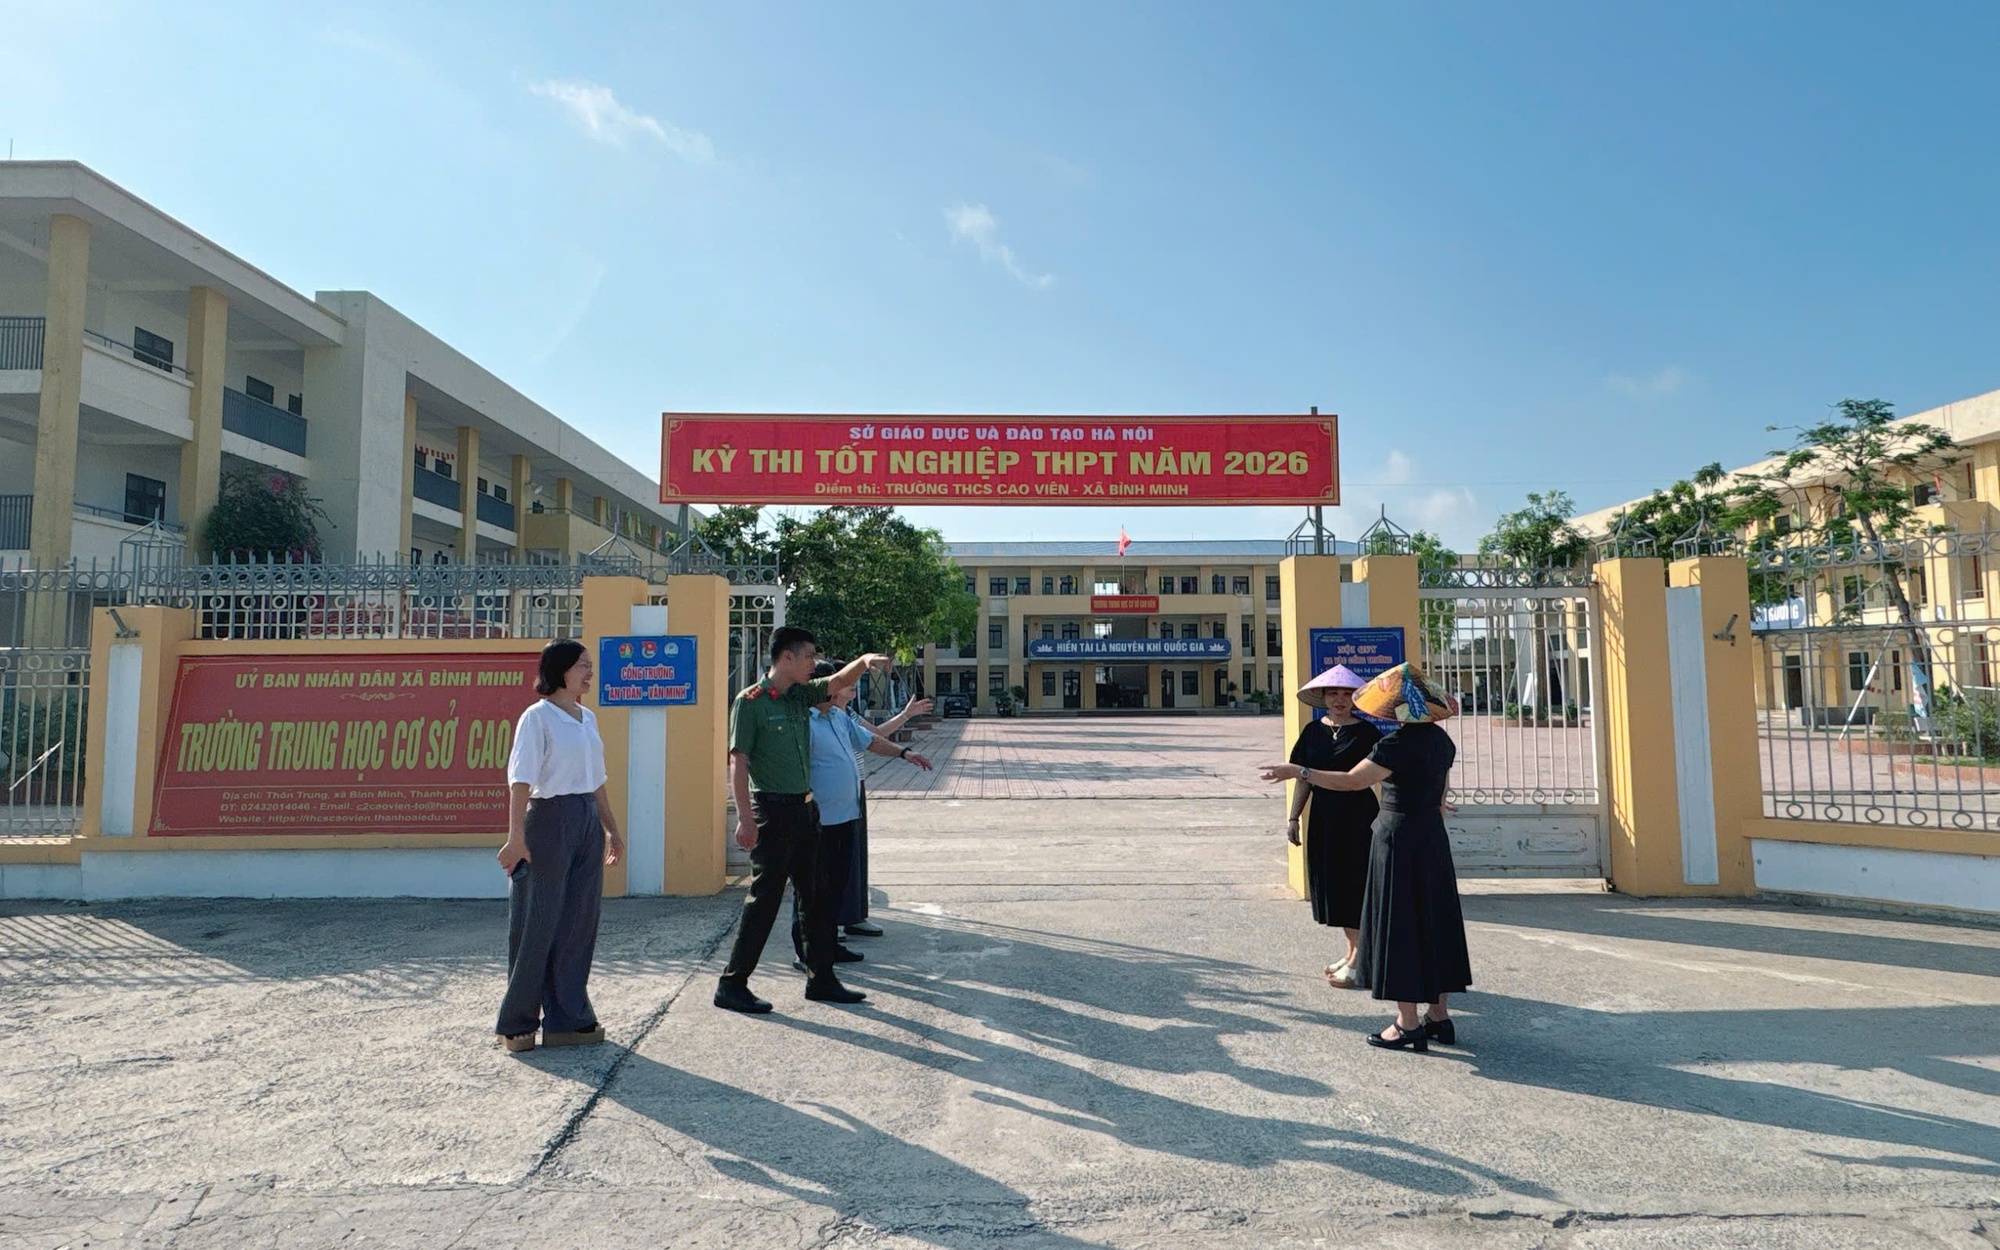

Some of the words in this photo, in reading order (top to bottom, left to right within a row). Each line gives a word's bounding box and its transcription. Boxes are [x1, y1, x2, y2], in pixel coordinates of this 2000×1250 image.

[850, 424, 876, 440] SỞ
[881, 425, 925, 440] GIÁO
[932, 427, 969, 443] DỤC
[976, 426, 1000, 440] VÀ
[1006, 427, 1044, 441] ĐÀO
[1050, 428, 1084, 443] TẠO
[1091, 427, 1115, 441] HÀ
[1122, 427, 1154, 443] NỘI
[692, 444, 738, 474] KỲ
[749, 449, 804, 474] THI
[815, 442, 878, 475] TỐT
[889, 446, 1020, 480] NGHIỆP
[1031, 450, 1118, 476] THPT
[1129, 446, 1212, 476] NĂM
[1223, 451, 1309, 476] 2026
[814, 479, 852, 495] Điểm
[857, 483, 881, 495] thi:
[885, 480, 949, 495] TRƯỜNG
[953, 483, 993, 495] THCS
[997, 483, 1030, 496] CAO
[1034, 482, 1069, 496] VIÊN
[1083, 481, 1105, 496] XÃ
[1109, 481, 1145, 496] BÌNH
[1149, 483, 1189, 496] MINH
[1080, 641, 1094, 653] TÀI
[1095, 641, 1107, 653] LÀ
[1109, 641, 1145, 653] NGUYÊN
[1146, 640, 1162, 653] KHÍ
[1163, 639, 1187, 654] QUỐC
[1189, 642, 1205, 652] GIA
[235, 667, 259, 688] UỶ
[263, 673, 300, 688] BAN
[304, 670, 355, 688] NHÂN
[359, 669, 396, 687] DÂN
[401, 669, 424, 687] XÃ
[429, 668, 472, 687] BÌNH
[477, 671, 524, 686] MINH
[643, 663, 675, 680] TRƯỜNG
[621, 683, 642, 700] TOÀN
[648, 683, 664, 700] VĂN
[664, 682, 691, 700] MINH"
[177, 709, 264, 772] TRƯỜNG
[267, 720, 340, 771] TRUNG
[341, 719, 388, 781] HỌC
[391, 716, 425, 770] CƠ
[425, 699, 460, 770] SỞ
[466, 719, 511, 769] CAO
[222, 791, 240, 801] Địa
[297, 790, 330, 801] Trung,
[377, 789, 406, 800] Minh,
[469, 789, 483, 798] Hà
[487, 788, 505, 800] Nội
[320, 802, 353, 810] Email:
